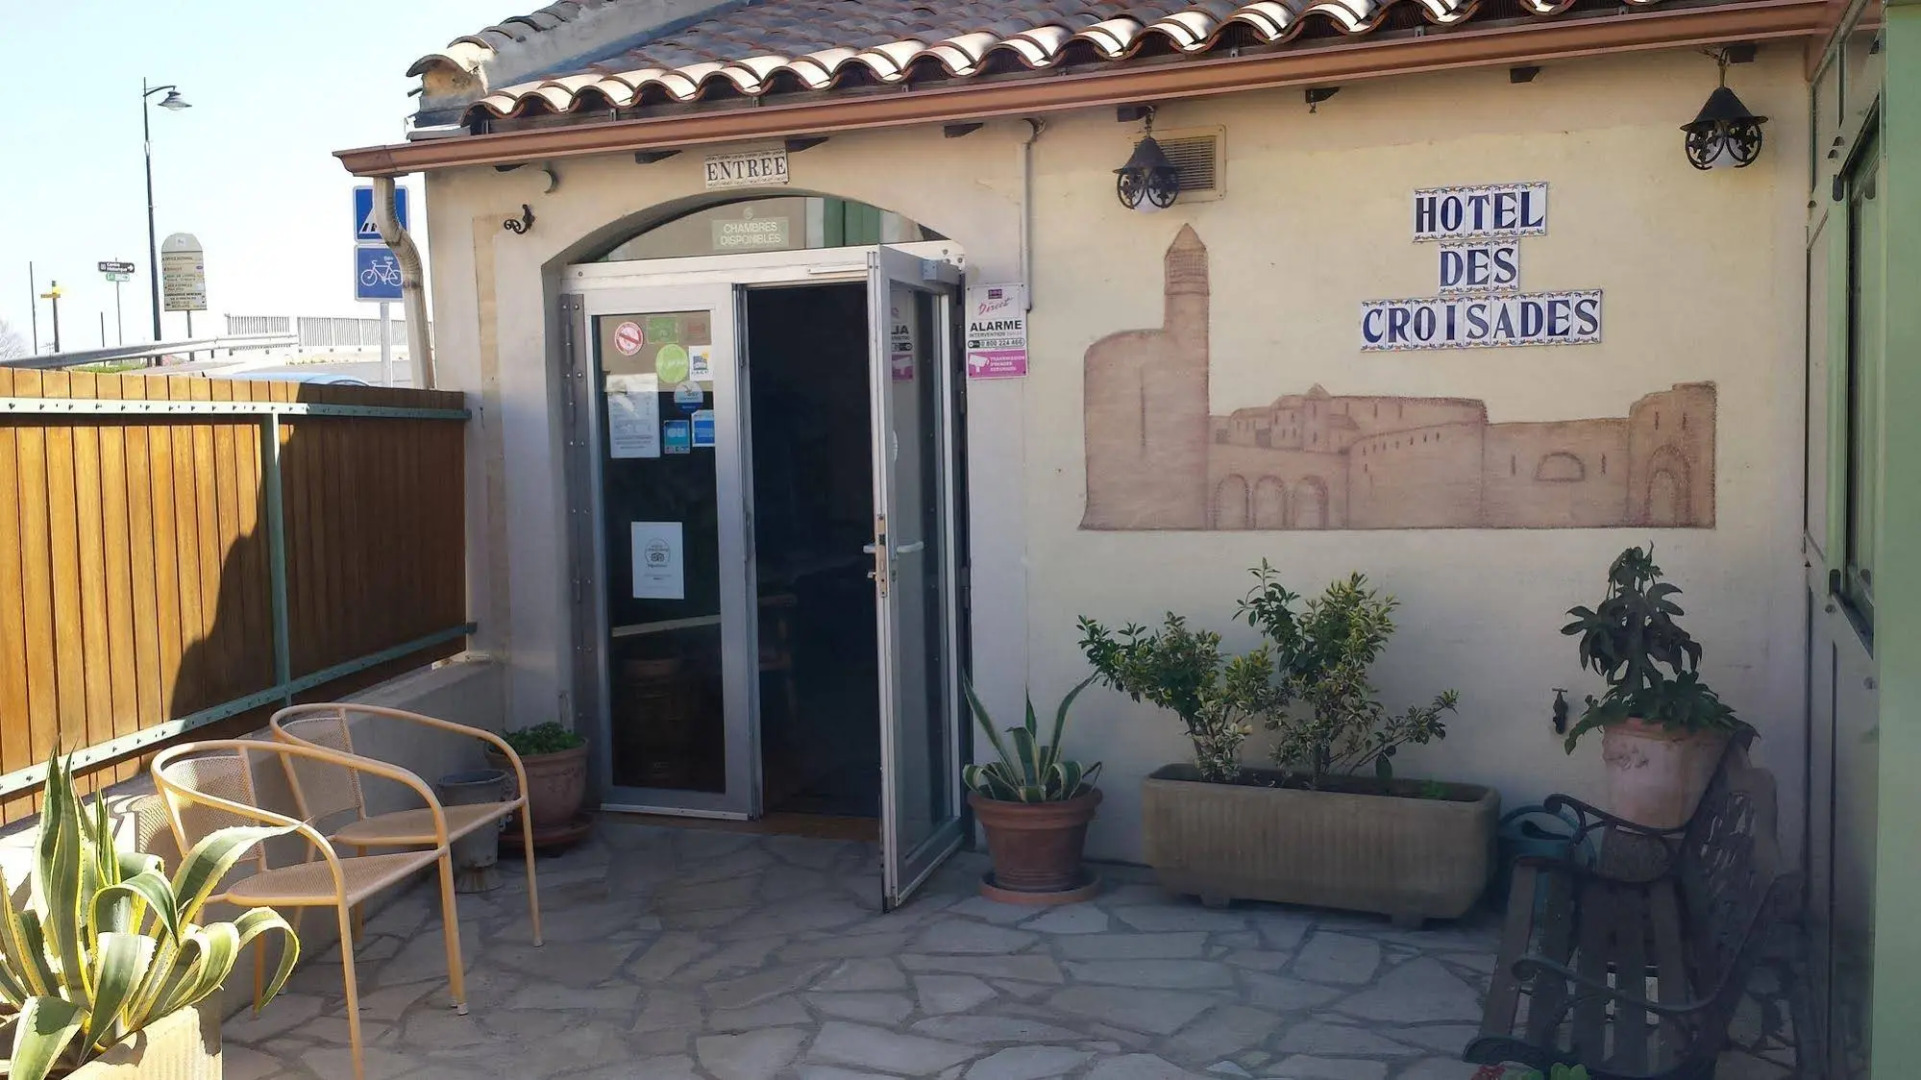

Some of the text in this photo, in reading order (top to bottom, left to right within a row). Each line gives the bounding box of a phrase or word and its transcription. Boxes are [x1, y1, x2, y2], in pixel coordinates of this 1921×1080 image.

[707, 156, 786, 181] ENTREE
[1415, 191, 1544, 233] HOTEL
[720, 233, 781, 245] DISPONIBLES
[723, 221, 778, 234] CHAMBRES
[1440, 248, 1517, 287] DES
[970, 320, 1022, 331] ALARME
[1363, 299, 1599, 343] CROISADES
